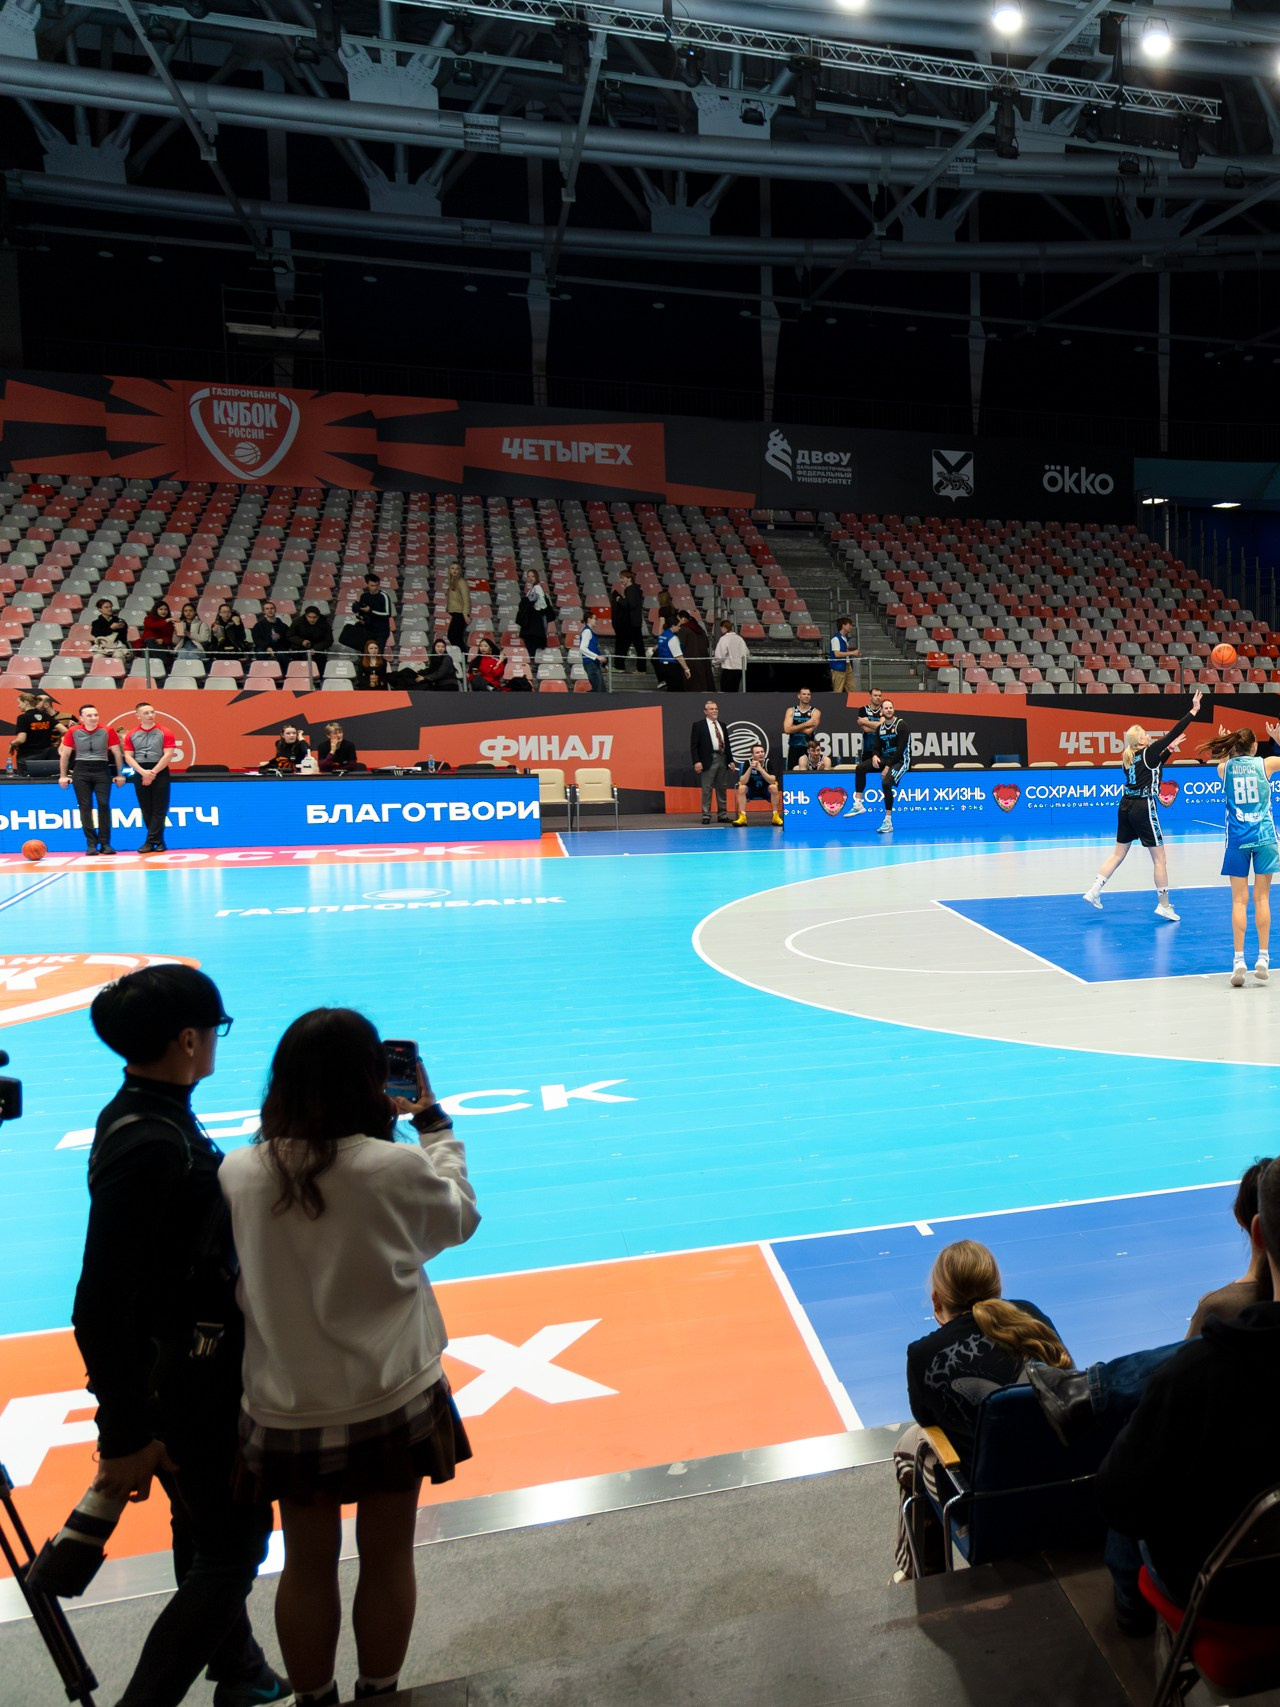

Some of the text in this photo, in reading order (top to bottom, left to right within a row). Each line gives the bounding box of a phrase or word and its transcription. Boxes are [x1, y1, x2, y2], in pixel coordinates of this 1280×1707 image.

[212, 387, 278, 399] ГАЗПРОМБАНК
[213, 400, 278, 428] КУБОК
[228, 427, 264, 440] РОССИИ
[500, 436, 633, 466] ЧЕТЫРЕХ
[796, 450, 852, 465] ДВФУ
[796, 470, 852, 478] ФЕДЕРАЛЬНЫЙ
[797, 476, 852, 485] УНИВЕРСИТЕТ
[480, 735, 614, 761] ФИНАЛ
[782, 732, 978, 757] ГЗПРБАНК
[934, 787, 986, 801] ЖИЗНЬ
[1025, 784, 1096, 799] СОХРАНИ
[1233, 777, 1260, 804] 88
[112, 806, 219, 828] МТЧ
[306, 800, 540, 824] БЛАГОТВОРИ
[216, 896, 567, 918] ГАЗПРОМБАНК
